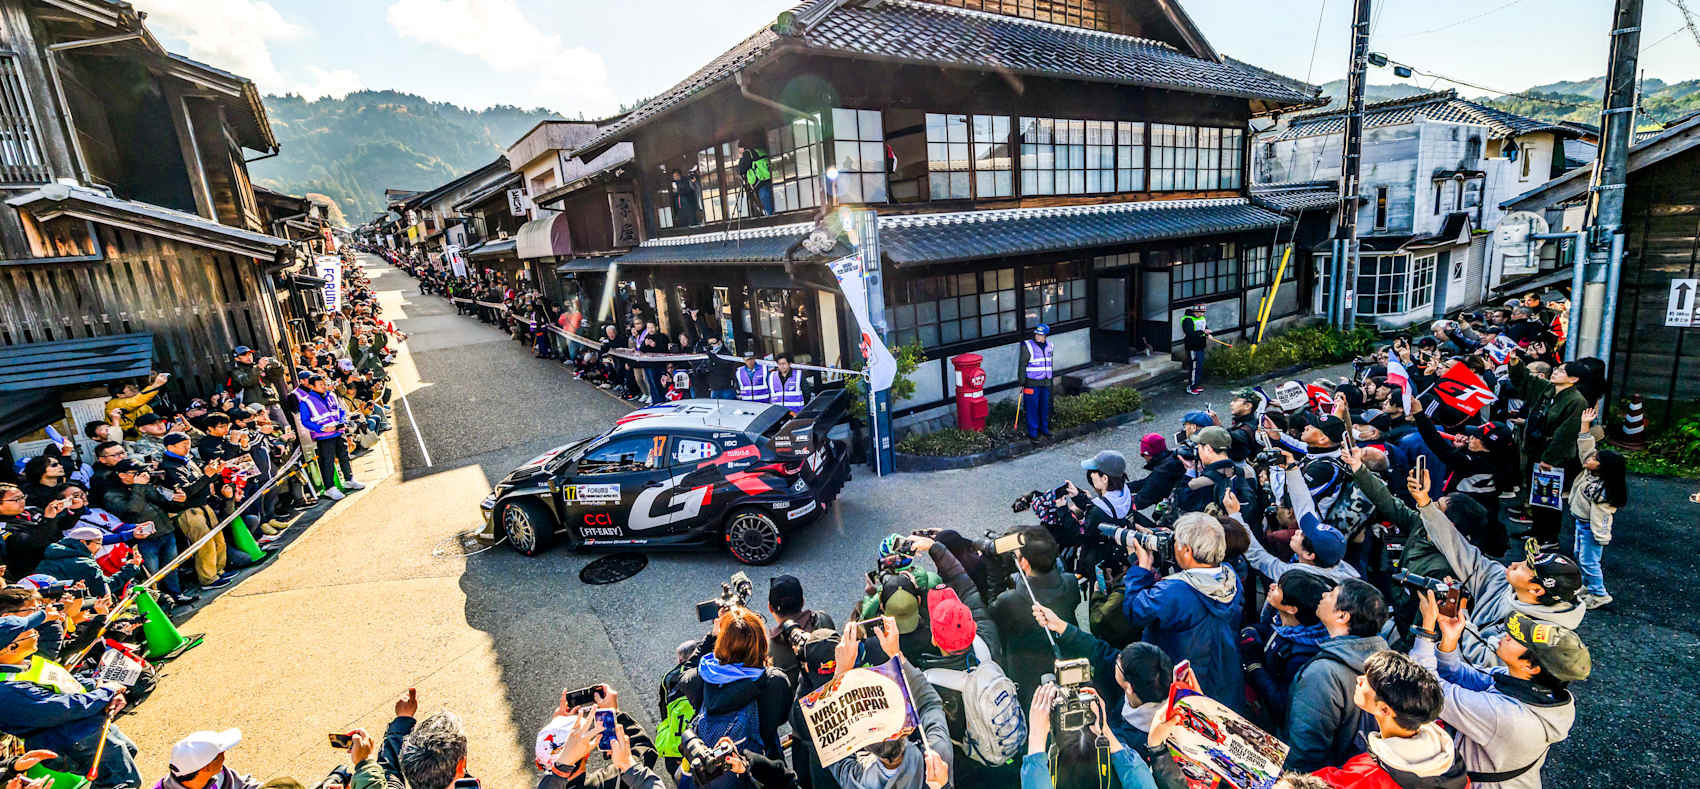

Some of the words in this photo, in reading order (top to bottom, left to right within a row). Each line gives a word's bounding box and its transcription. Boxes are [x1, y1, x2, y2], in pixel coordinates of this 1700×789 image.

[653, 436, 667, 456] 17
[565, 486, 576, 500] 17
[810, 701, 838, 726] WRC
[838, 685, 885, 708] FORUM8
[814, 708, 848, 737] RALLY
[851, 697, 889, 716] JAPAN
[818, 725, 849, 748] 2025
